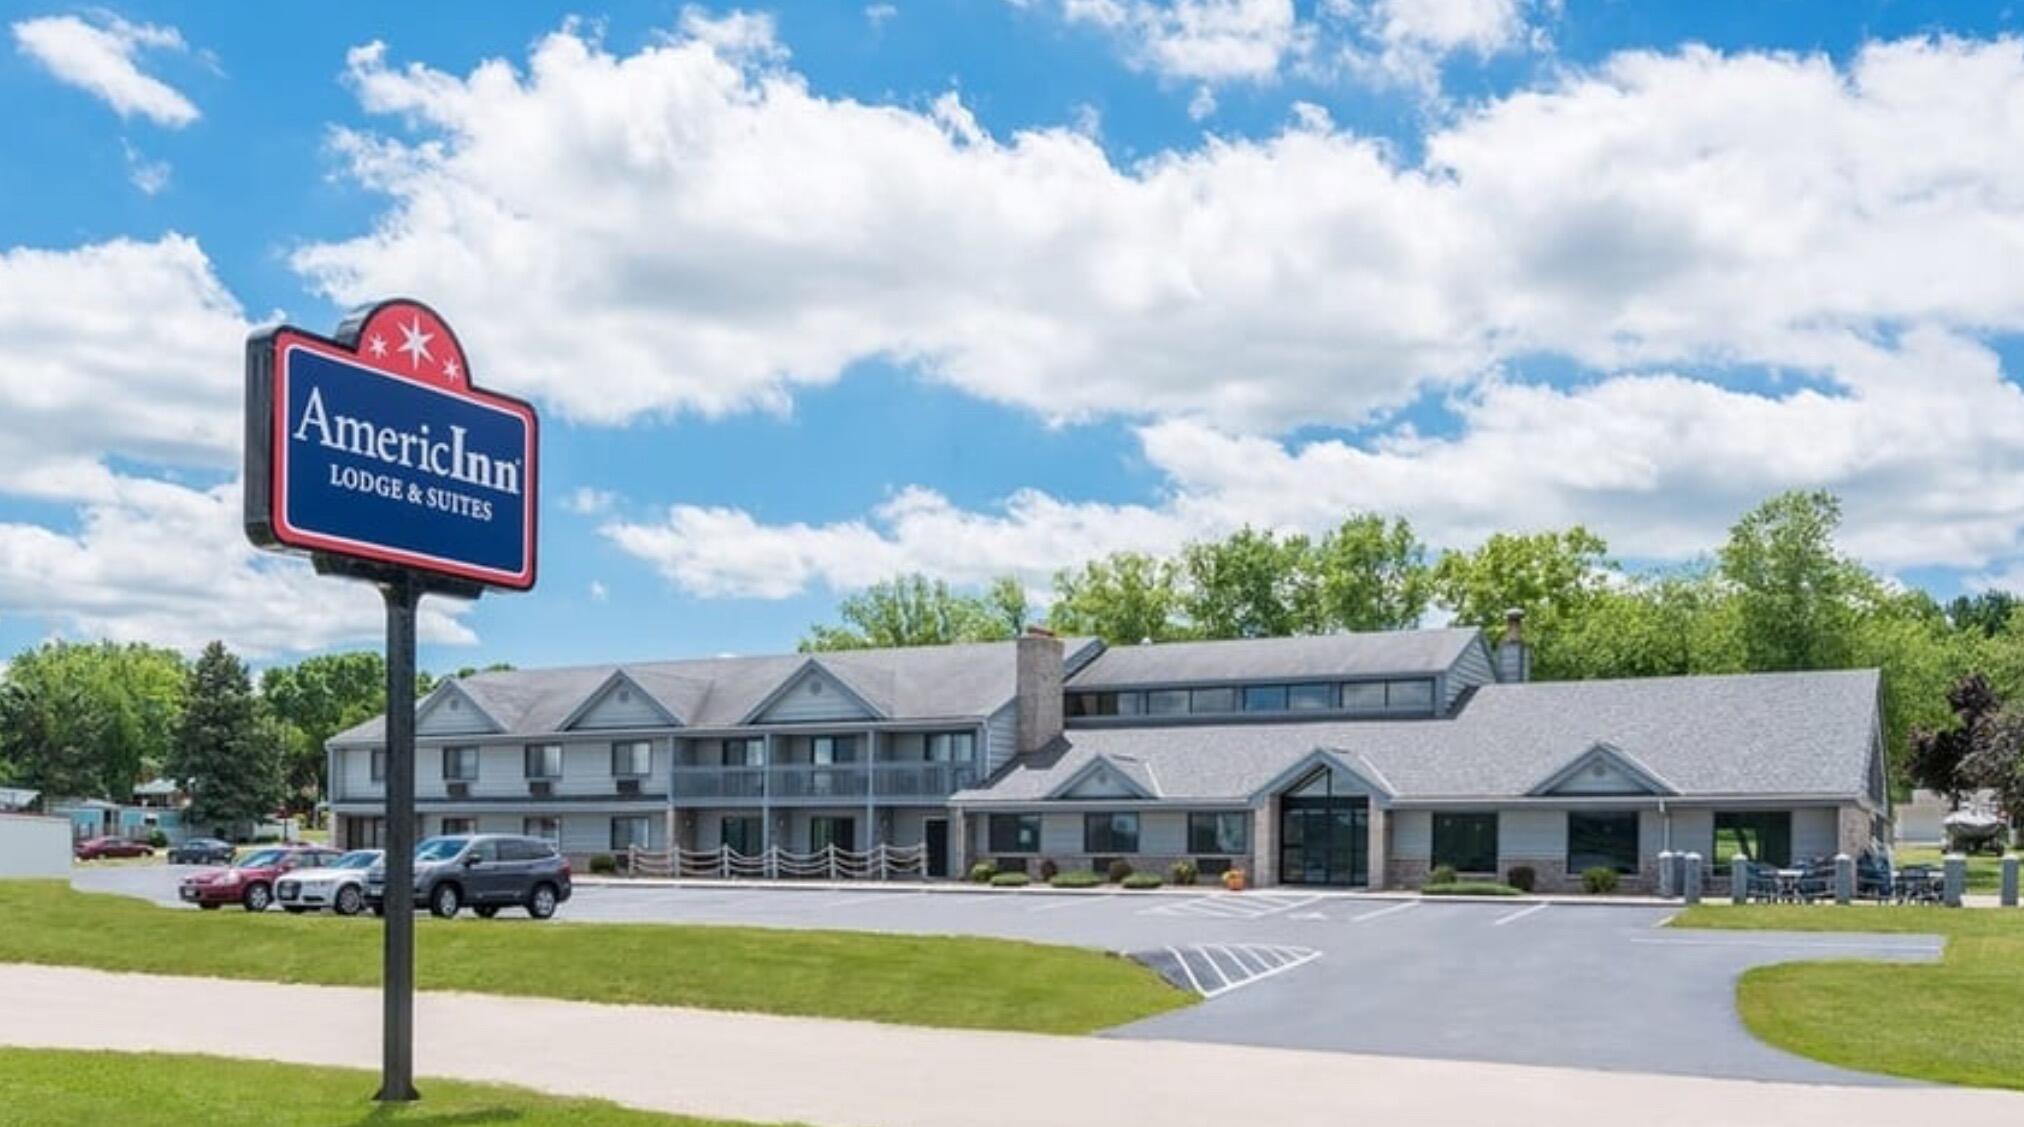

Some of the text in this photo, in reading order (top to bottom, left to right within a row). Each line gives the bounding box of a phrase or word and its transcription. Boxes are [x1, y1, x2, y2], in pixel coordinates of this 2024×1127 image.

[293, 386, 519, 494] AmericInn
[330, 464, 493, 521] LODGE & SUITES
